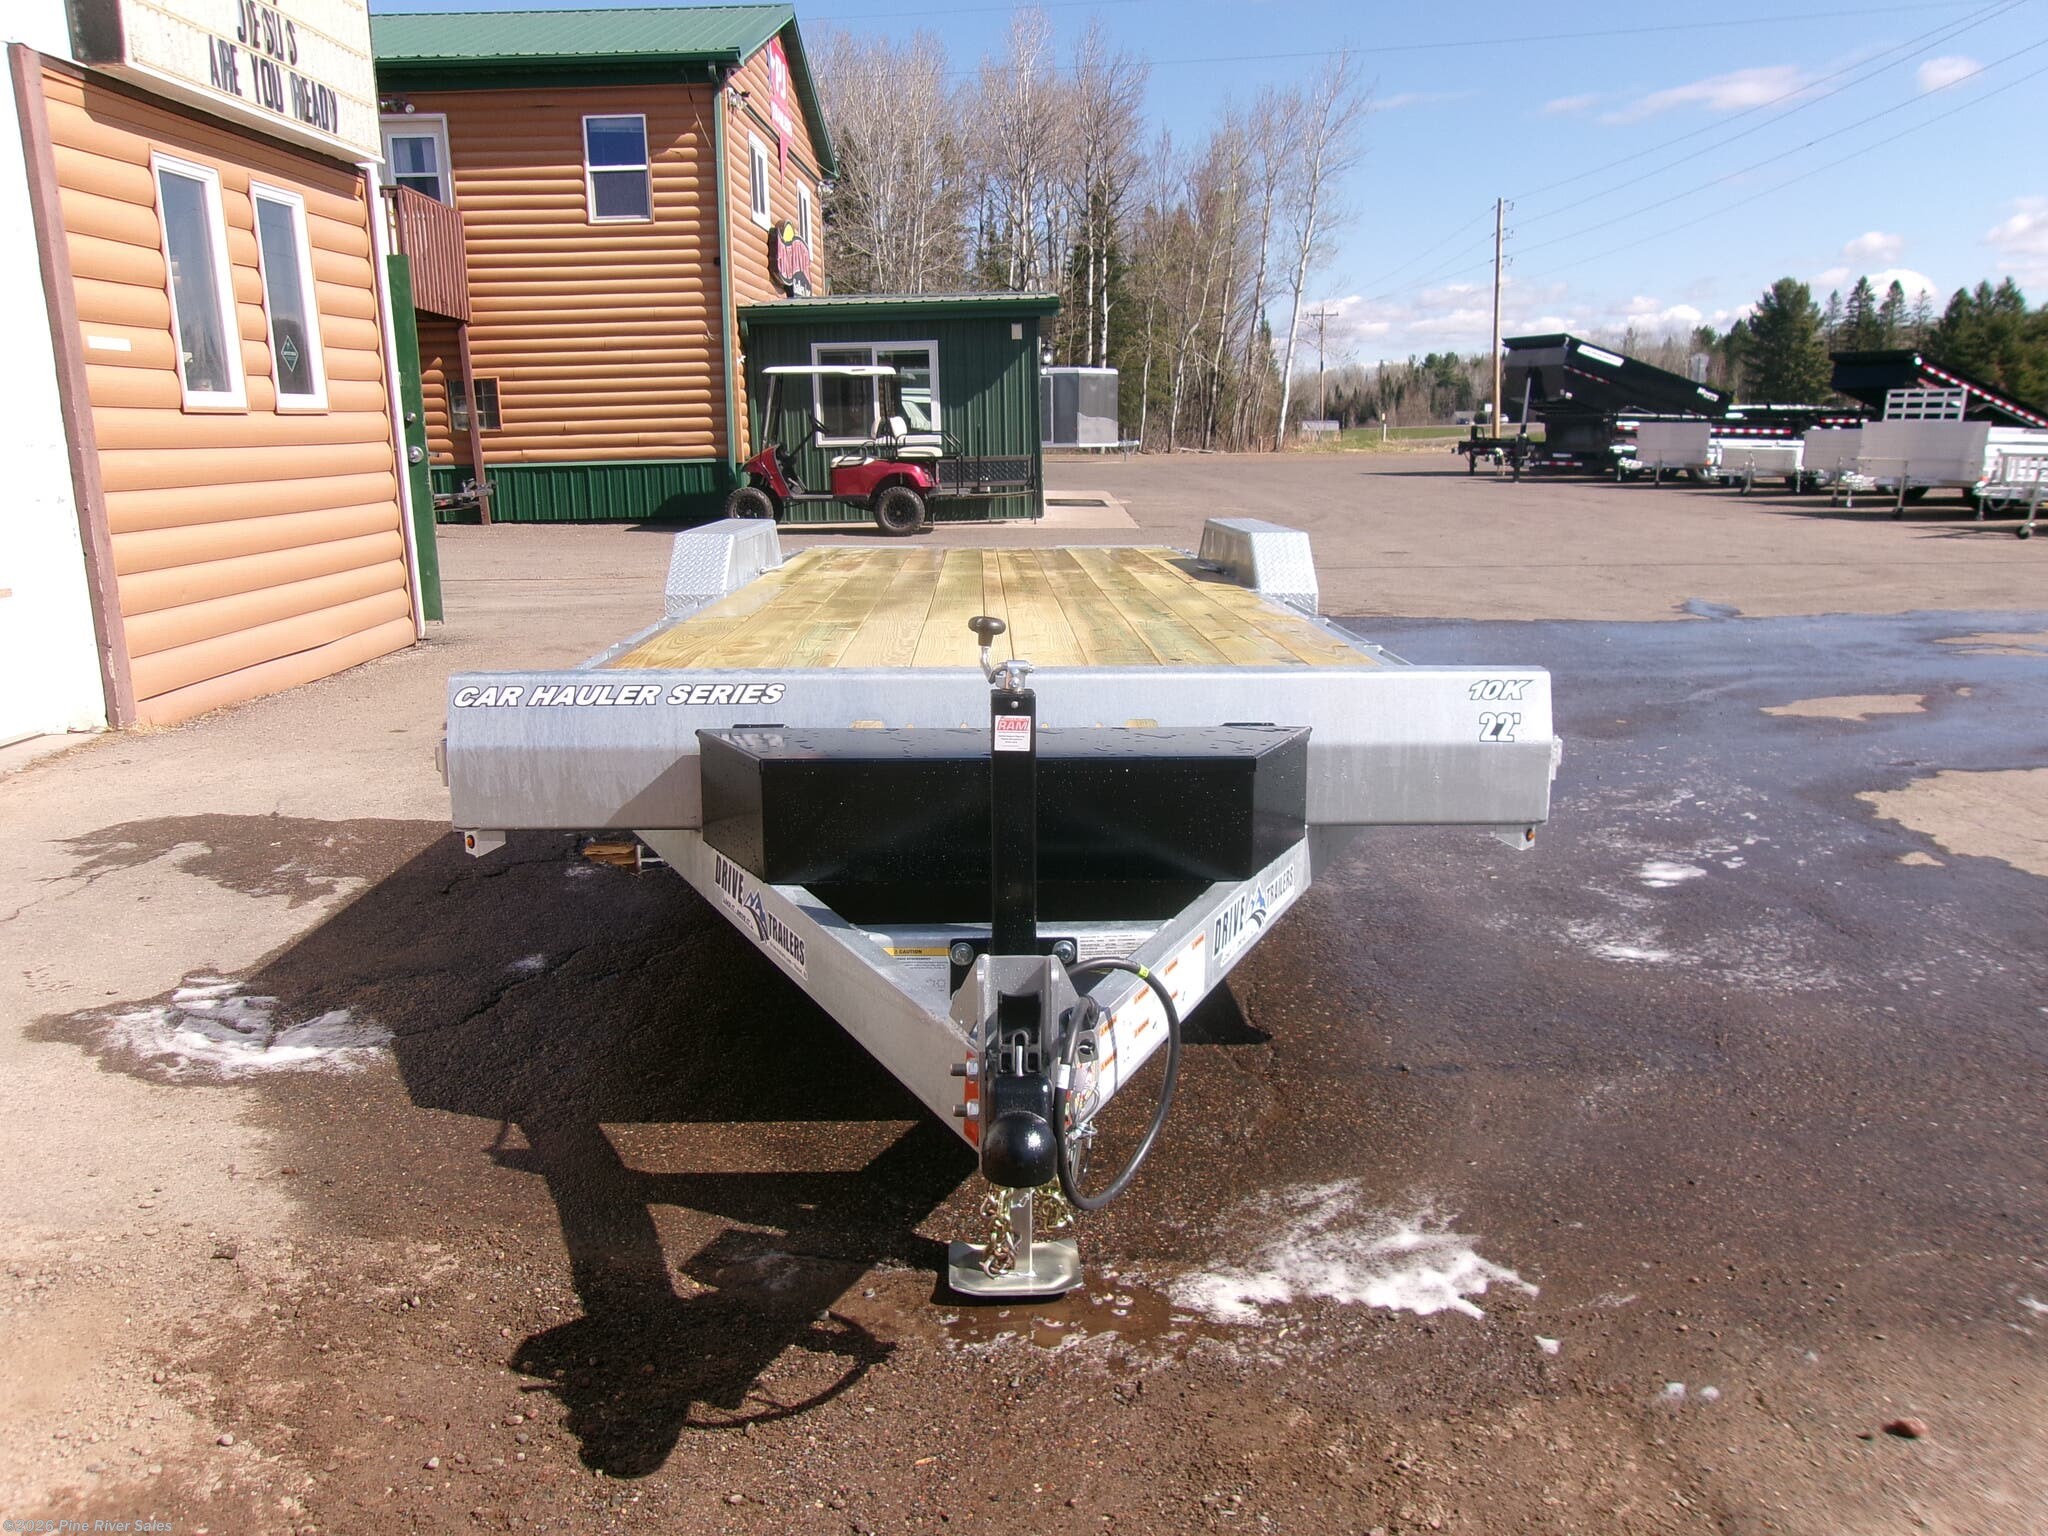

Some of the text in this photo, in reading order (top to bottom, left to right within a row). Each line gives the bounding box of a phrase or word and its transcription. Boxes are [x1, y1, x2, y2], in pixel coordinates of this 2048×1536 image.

[237, 0, 297, 66] JESUS
[208, 34, 337, 134] ARE YOU READY
[774, 53, 787, 100] PJ
[453, 683, 786, 707] CAR HAULER SERIES
[1468, 679, 1536, 701] 10K
[998, 720, 1029, 731] RAM
[1479, 711, 1521, 742] 22'
[715, 854, 744, 906] DRIVE
[767, 912, 805, 966] TRAILERS
[1214, 895, 1246, 956] DRIVE
[1266, 865, 1295, 908] TRAILERS
